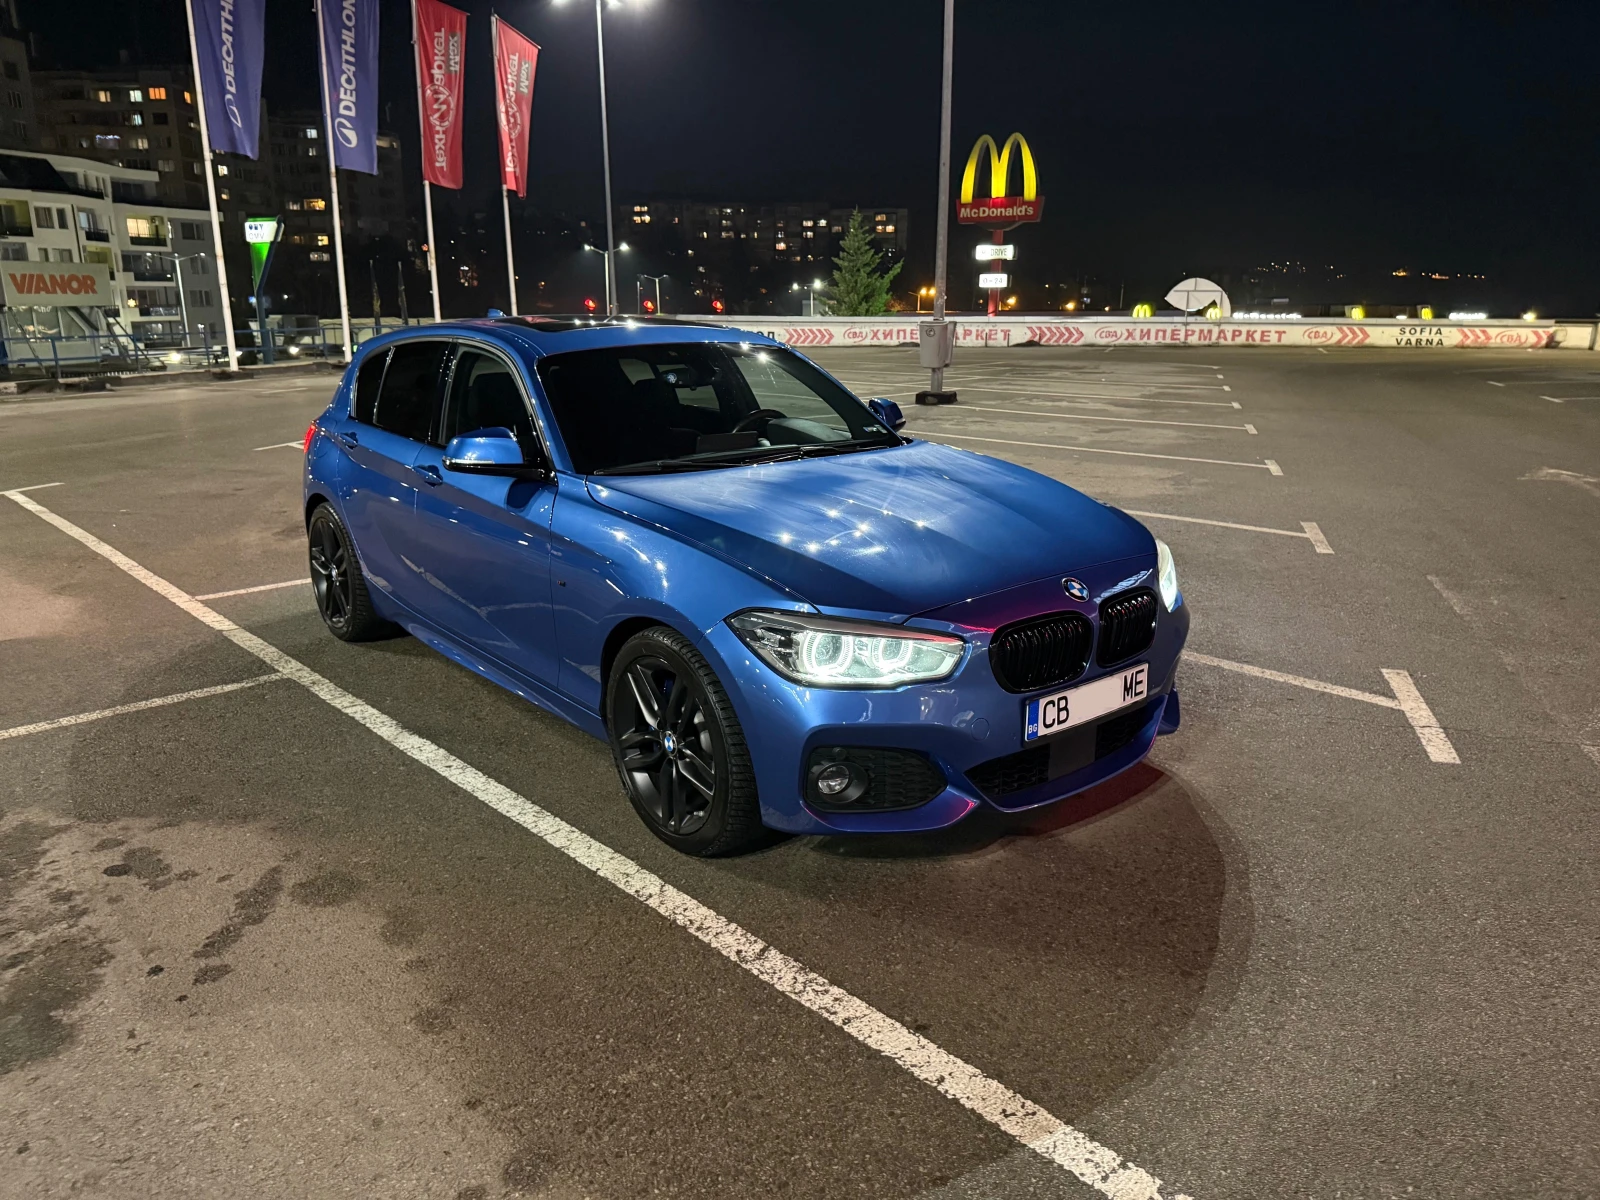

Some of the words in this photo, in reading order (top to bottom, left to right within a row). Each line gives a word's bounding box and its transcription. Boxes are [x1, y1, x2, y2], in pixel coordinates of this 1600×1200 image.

[960, 205, 1034, 218] McDonald's
[990, 247, 1008, 256] DRIVE
[8, 273, 98, 295] VIANOR
[1125, 328, 1287, 343] ХИПЕРМАРКЕТ
[1398, 327, 1443, 336] SOFIA
[1395, 337, 1444, 346] VARNA
[1042, 695, 1069, 729] CB
[1123, 668, 1145, 702] ME
[1028, 723, 1038, 734] BG
